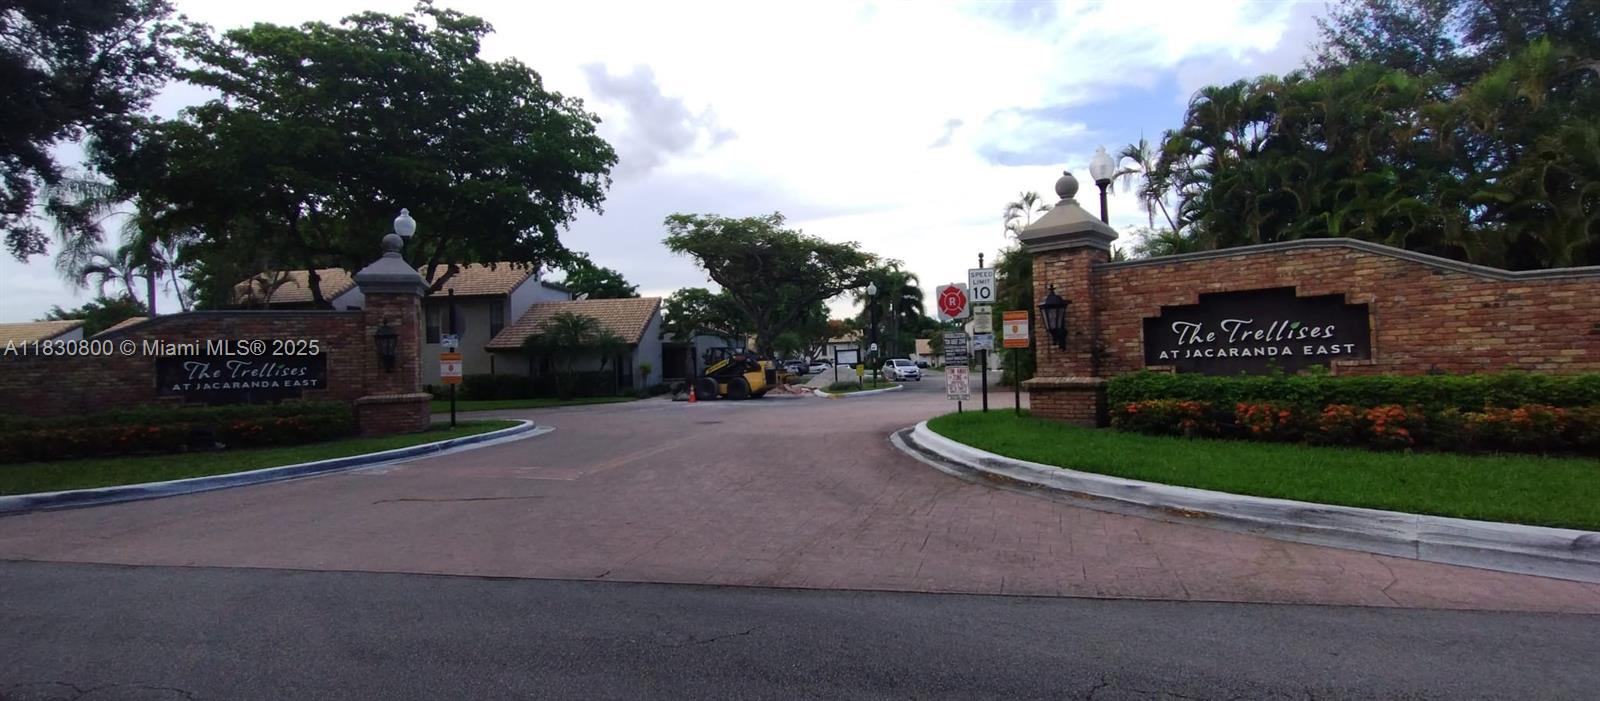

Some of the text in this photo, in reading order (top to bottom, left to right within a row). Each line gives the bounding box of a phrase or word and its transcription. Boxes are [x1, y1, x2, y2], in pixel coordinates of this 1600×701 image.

[973, 286, 991, 299] 10
[949, 297, 956, 306] R
[1172, 317, 1335, 346] The Trellises
[1159, 344, 1355, 360] AT JACARANDA EAST
[184, 359, 308, 380] The Trellises
[172, 379, 319, 391] AT JACARANDA EAST
